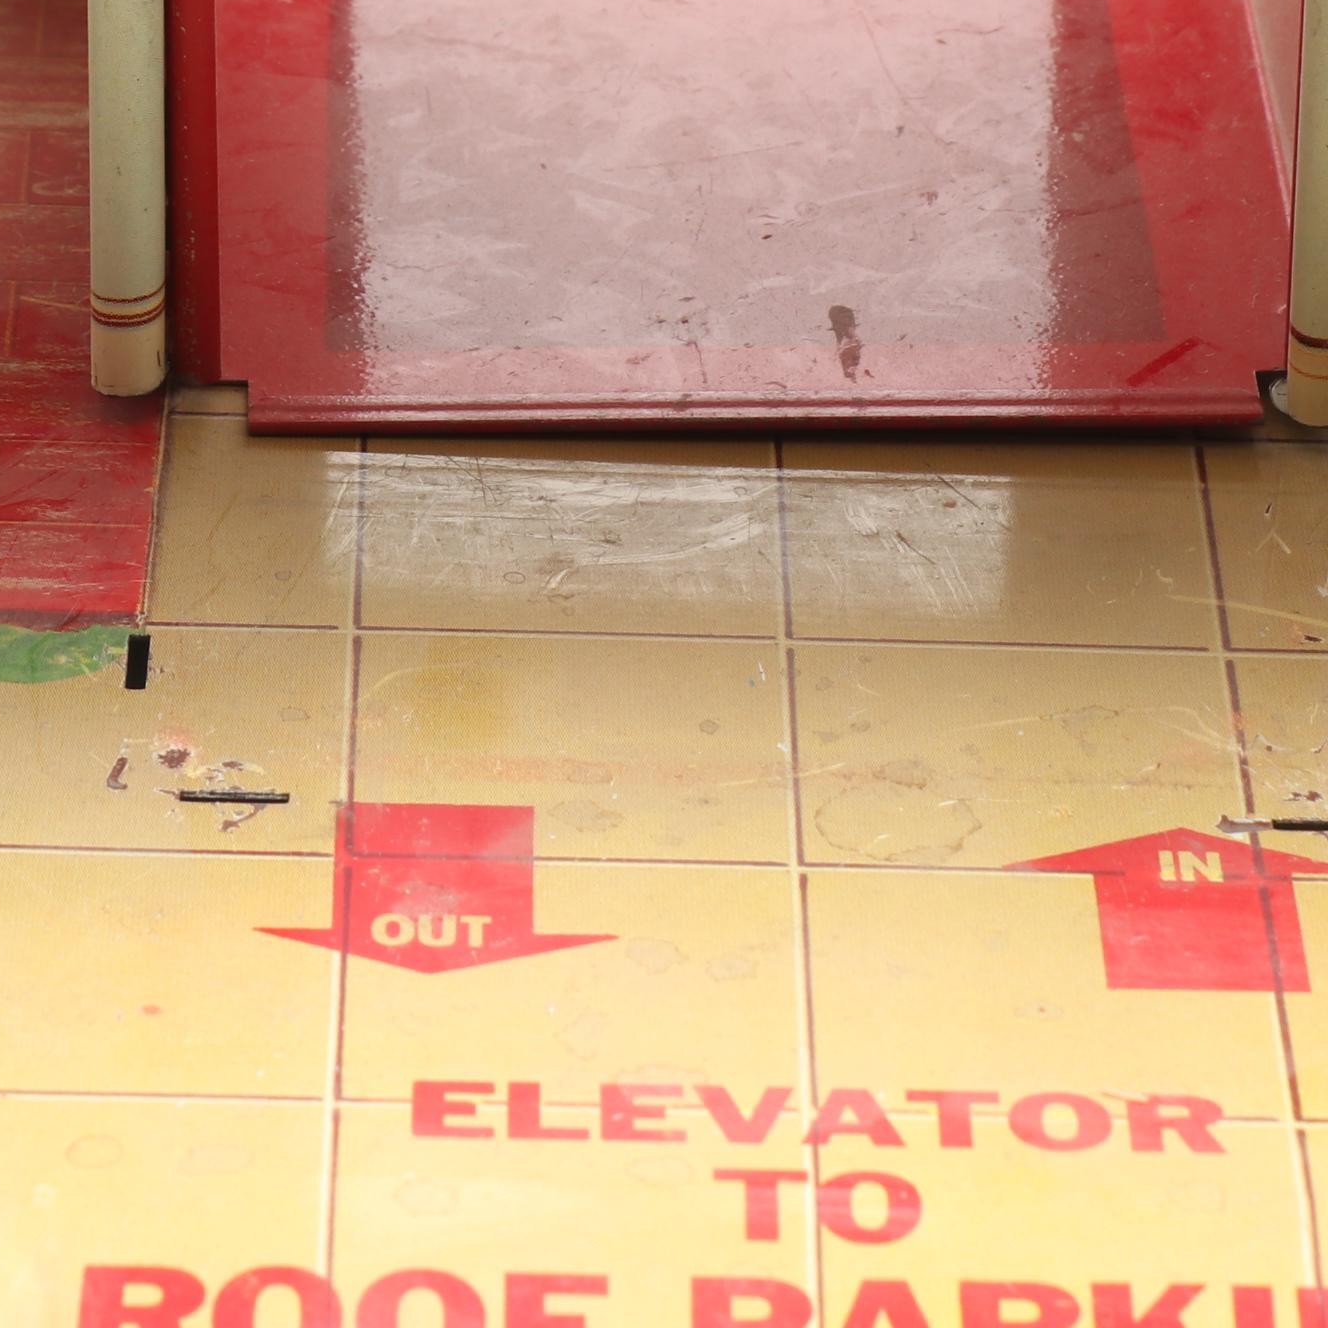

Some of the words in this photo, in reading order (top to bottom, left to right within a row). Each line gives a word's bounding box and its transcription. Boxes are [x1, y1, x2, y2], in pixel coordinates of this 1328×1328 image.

[1158, 850, 1224, 883] IN
[370, 912, 493, 948] OUT
[411, 1080, 1225, 1153] ELEVATOR
[714, 1169, 922, 1245] TO
